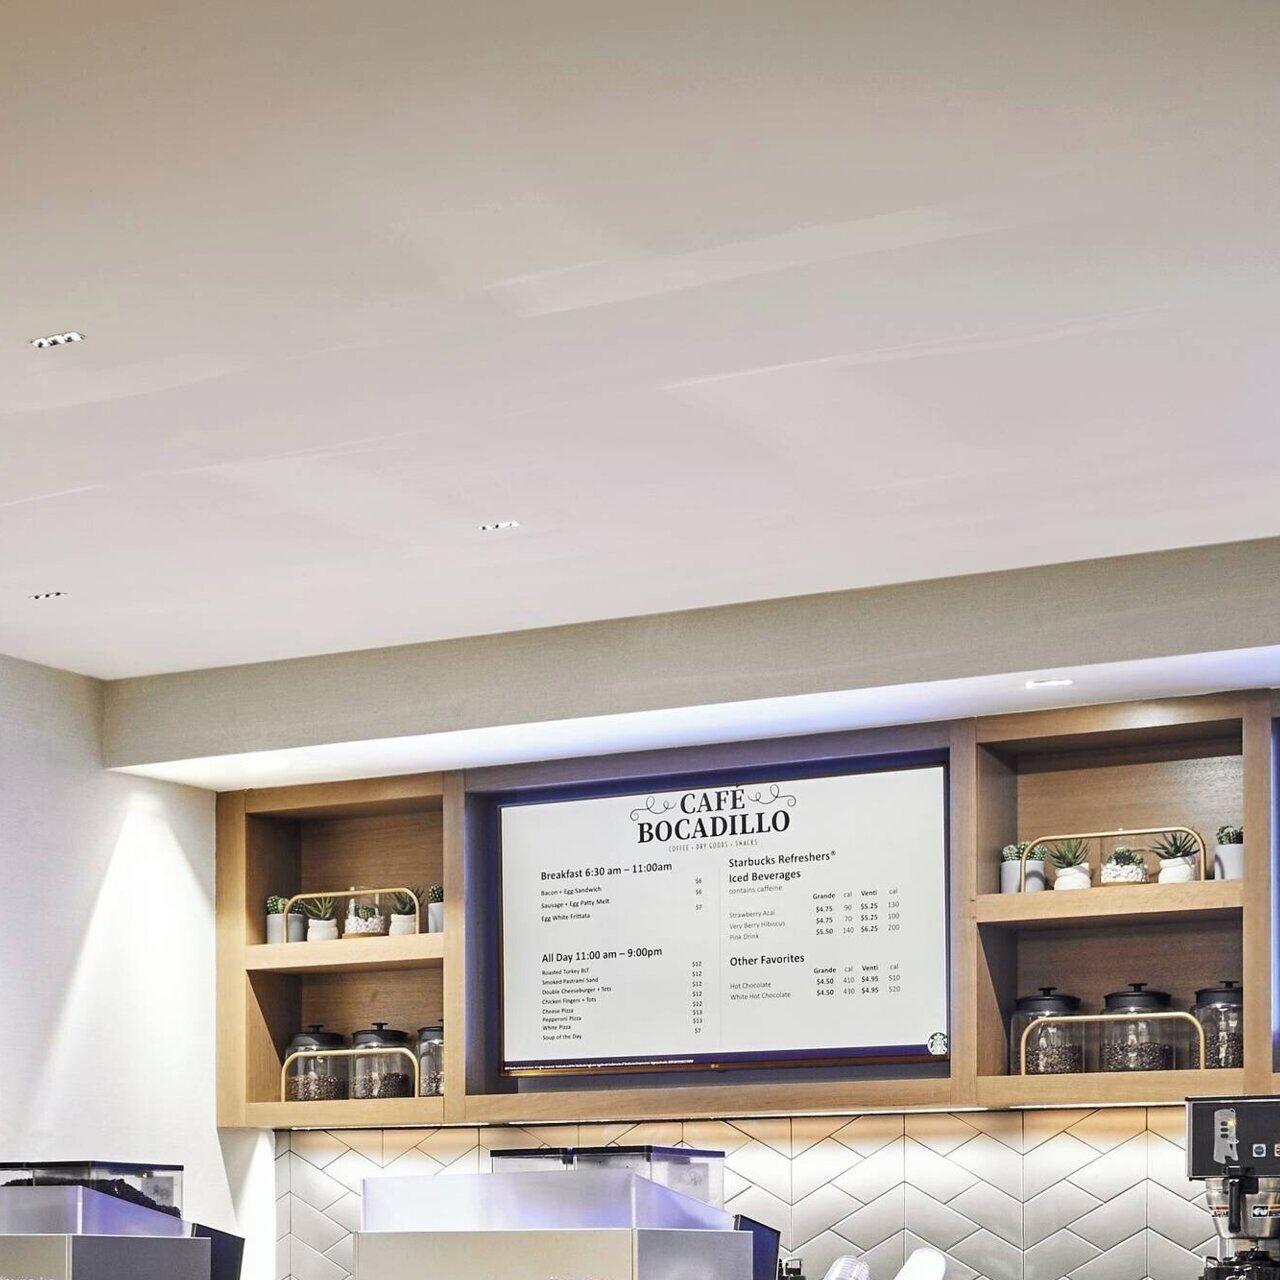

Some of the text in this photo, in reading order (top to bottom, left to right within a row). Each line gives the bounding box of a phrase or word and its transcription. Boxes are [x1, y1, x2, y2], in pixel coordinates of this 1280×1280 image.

[680, 785, 745, 814] CAFÉ
[638, 810, 790, 844] BOCADILLO
[729, 856, 775, 868] Starbucks
[541, 862, 672, 881] Breakfast 6:30 am 11:00am
[729, 871, 801, 883] Iced Beverages
[813, 892, 835, 900] Grande
[861, 925, 878, 933] $6.25
[542, 947, 662, 964] All Day 11:00 am 9:00pm
[730, 953, 804, 966] Other Favorites
[862, 975, 878, 983] $4.95
